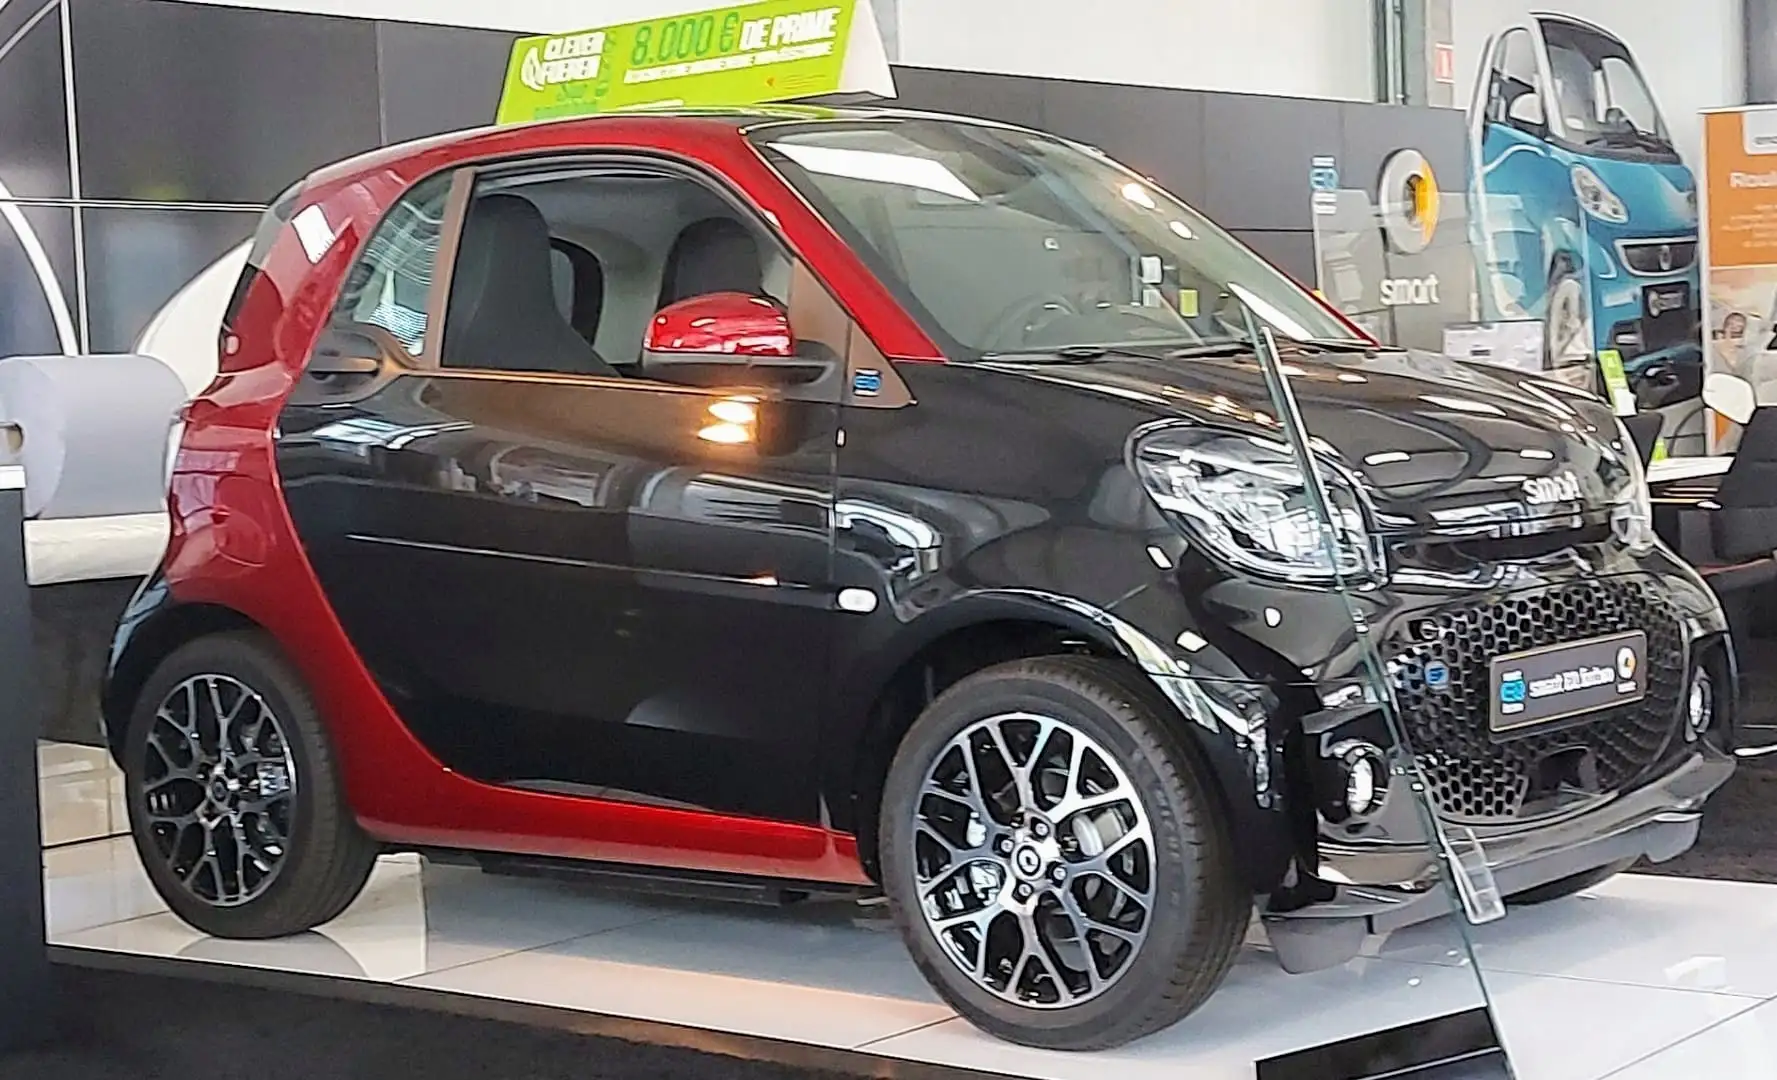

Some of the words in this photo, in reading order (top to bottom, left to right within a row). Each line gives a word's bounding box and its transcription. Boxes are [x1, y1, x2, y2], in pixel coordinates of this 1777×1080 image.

[632, 16, 714, 65] 8.000
[719, 11, 739, 52] €
[738, 18, 772, 52] DE
[773, 8, 841, 46] PRIME
[1379, 274, 1440, 305] smart
[1521, 470, 1584, 505] smart
